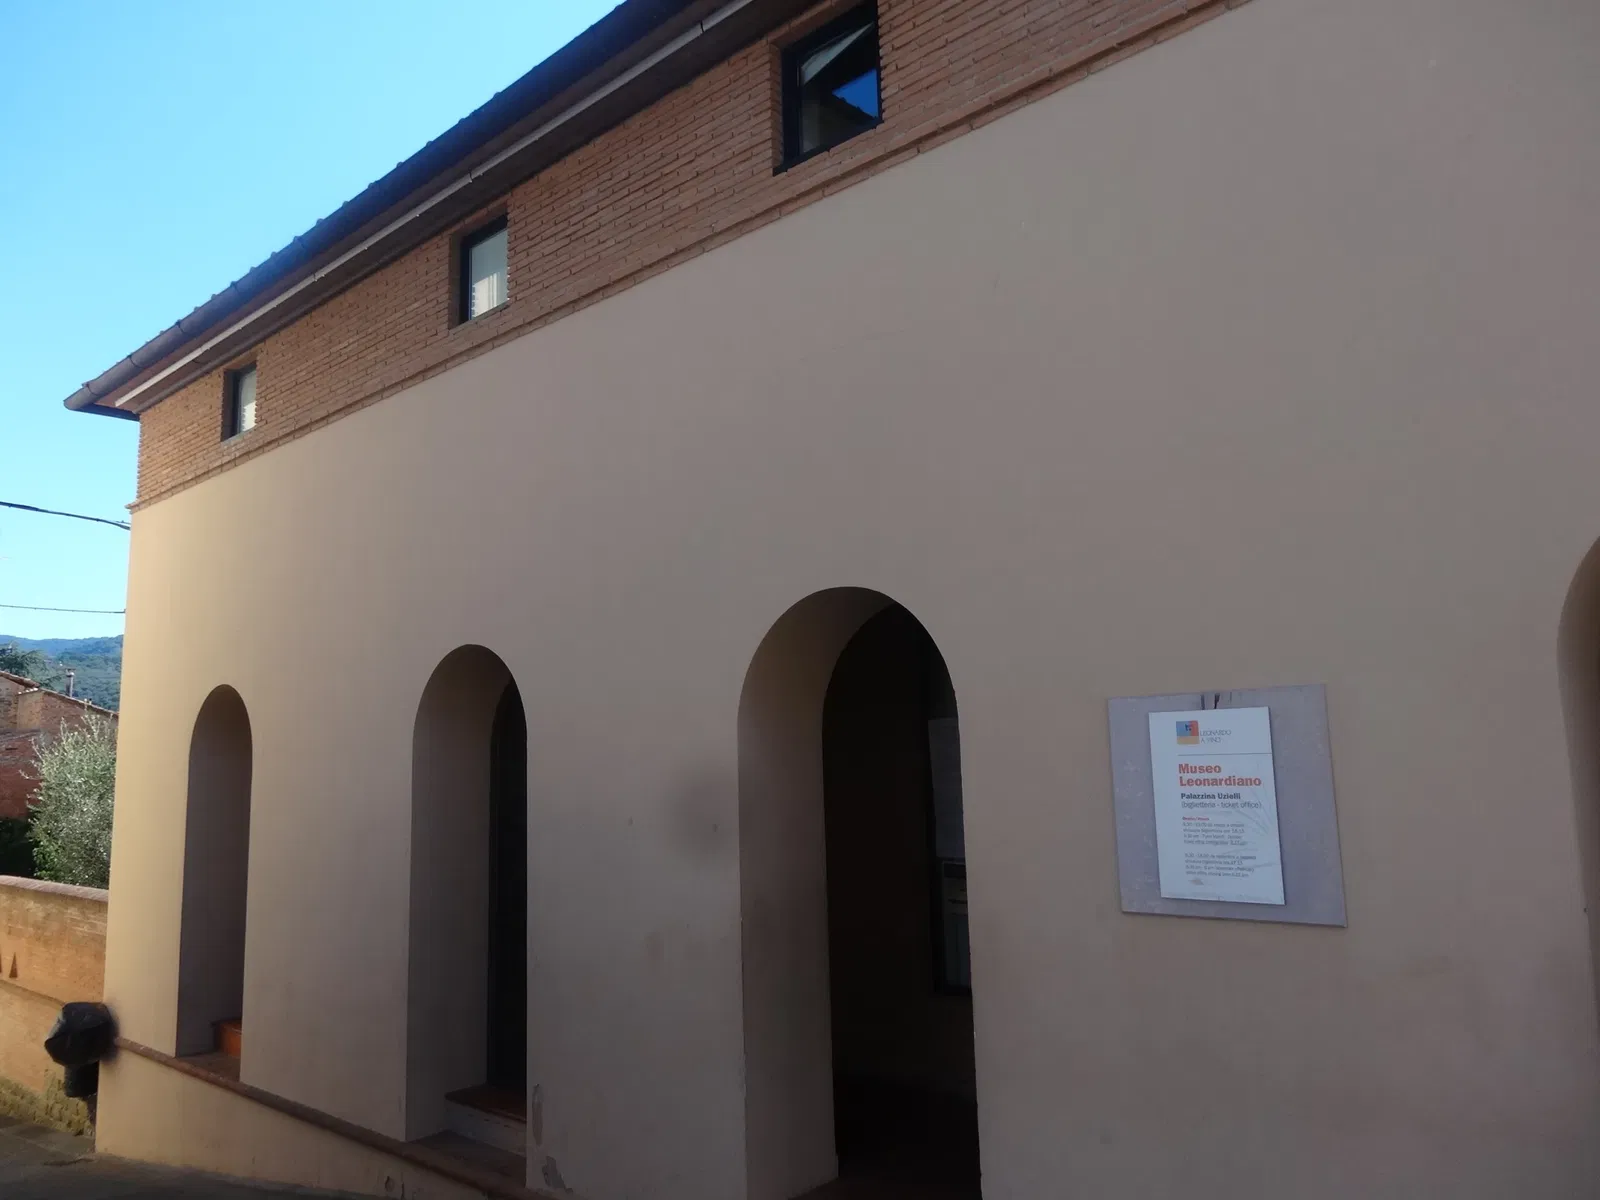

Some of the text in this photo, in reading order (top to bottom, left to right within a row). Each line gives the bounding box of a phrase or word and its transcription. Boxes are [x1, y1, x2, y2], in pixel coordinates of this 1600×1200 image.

[1178, 763, 1222, 774] Museo
[1179, 775, 1262, 787] Leonardiano
[1180, 792, 1216, 800] Palazzina
